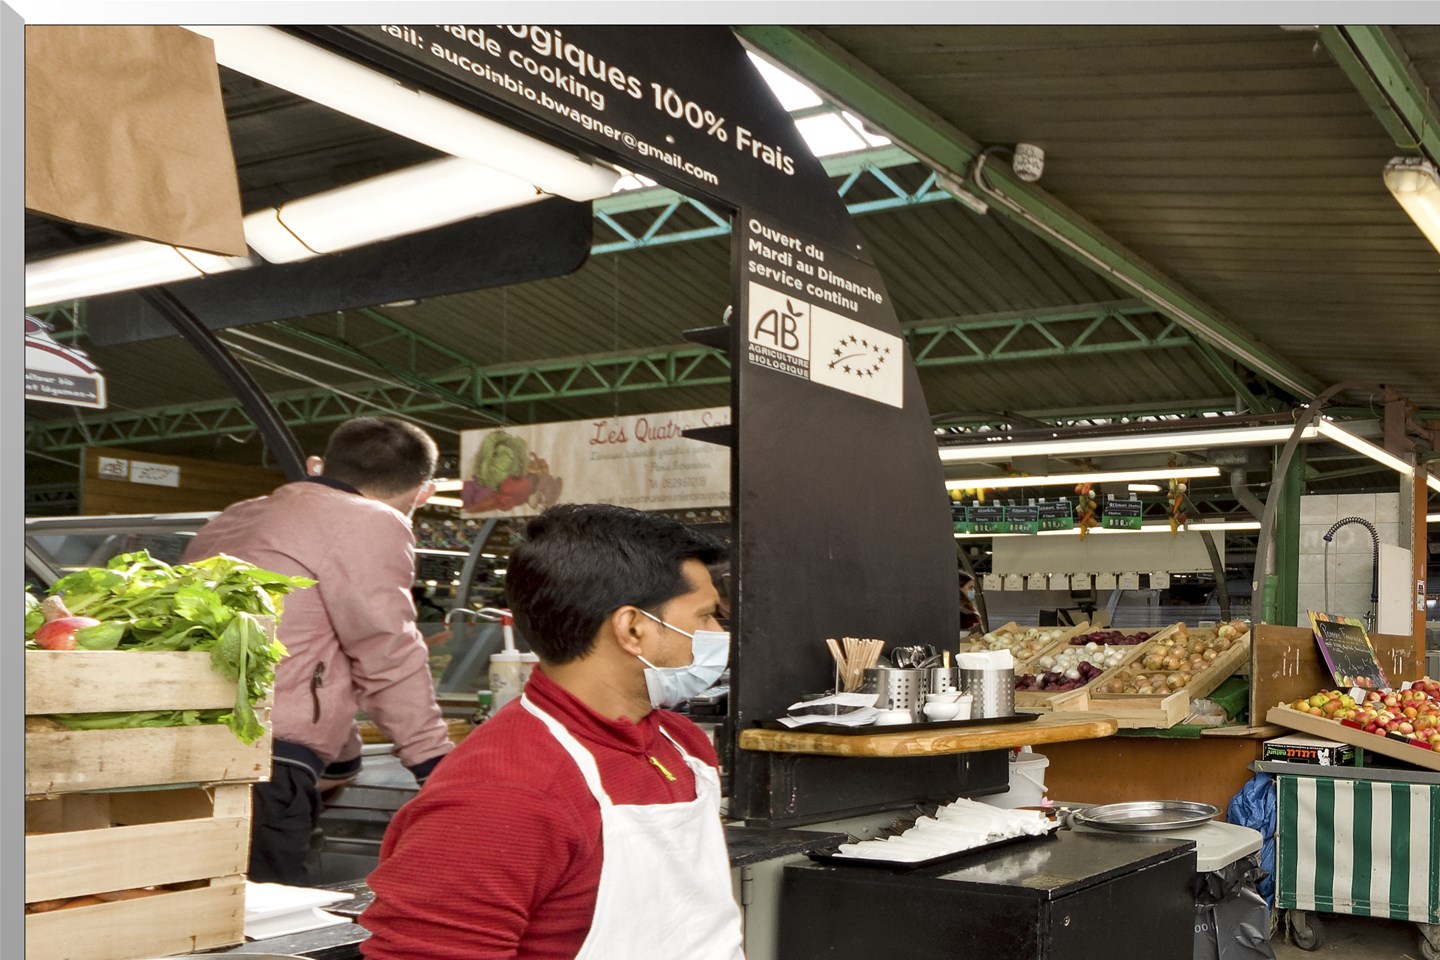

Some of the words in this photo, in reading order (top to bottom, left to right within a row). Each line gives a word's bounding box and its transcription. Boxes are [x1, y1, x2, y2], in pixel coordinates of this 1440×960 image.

[497, 25, 643, 100] ogiques
[651, 83, 728, 142] 100%
[736, 125, 795, 176] Frais
[508, 49, 605, 111] cooking
[431, 42, 719, 185] aucoinbio.bwagner@gmail.com
[749, 218, 802, 252] Ouvert
[805, 243, 825, 261] du
[749, 237, 793, 267] Mardi
[796, 259, 814, 276] au
[817, 265, 883, 304] Dimanche
[749, 260, 803, 290] service
[806, 282, 858, 312] continu
[754, 309, 800, 351] AB
[749, 342, 809, 368] AGRICULTURE
[749, 353, 809, 378] BIOLOGIQUE
[589, 420, 629, 446] Les
